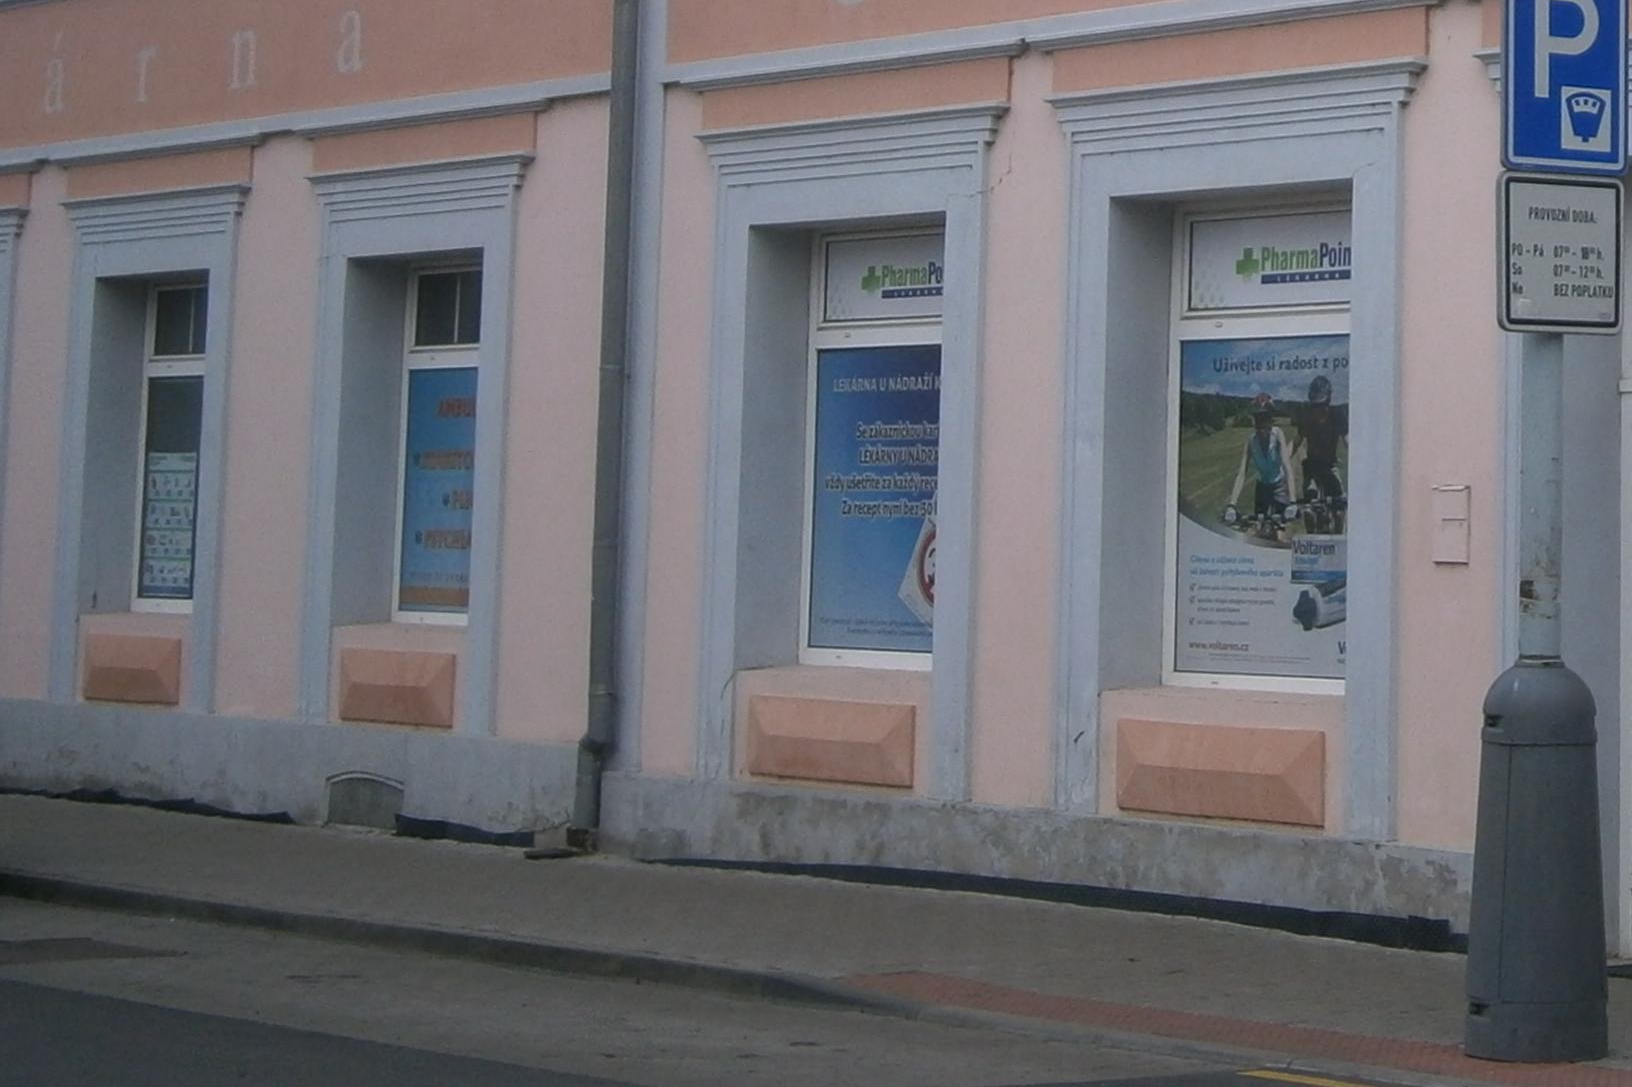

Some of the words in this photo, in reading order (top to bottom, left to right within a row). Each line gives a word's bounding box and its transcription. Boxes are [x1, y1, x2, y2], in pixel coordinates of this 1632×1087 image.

[1554, 283, 1569, 296] BEZ
[1571, 283, 1613, 298] POPLATKU
[1266, 357, 1275, 371] si
[1279, 355, 1318, 371] radost
[1320, 357, 1329, 369] z
[879, 376, 888, 392] U
[889, 372, 933, 392] NÁDRAŽÍ
[1292, 539, 1336, 555] Voltaren
